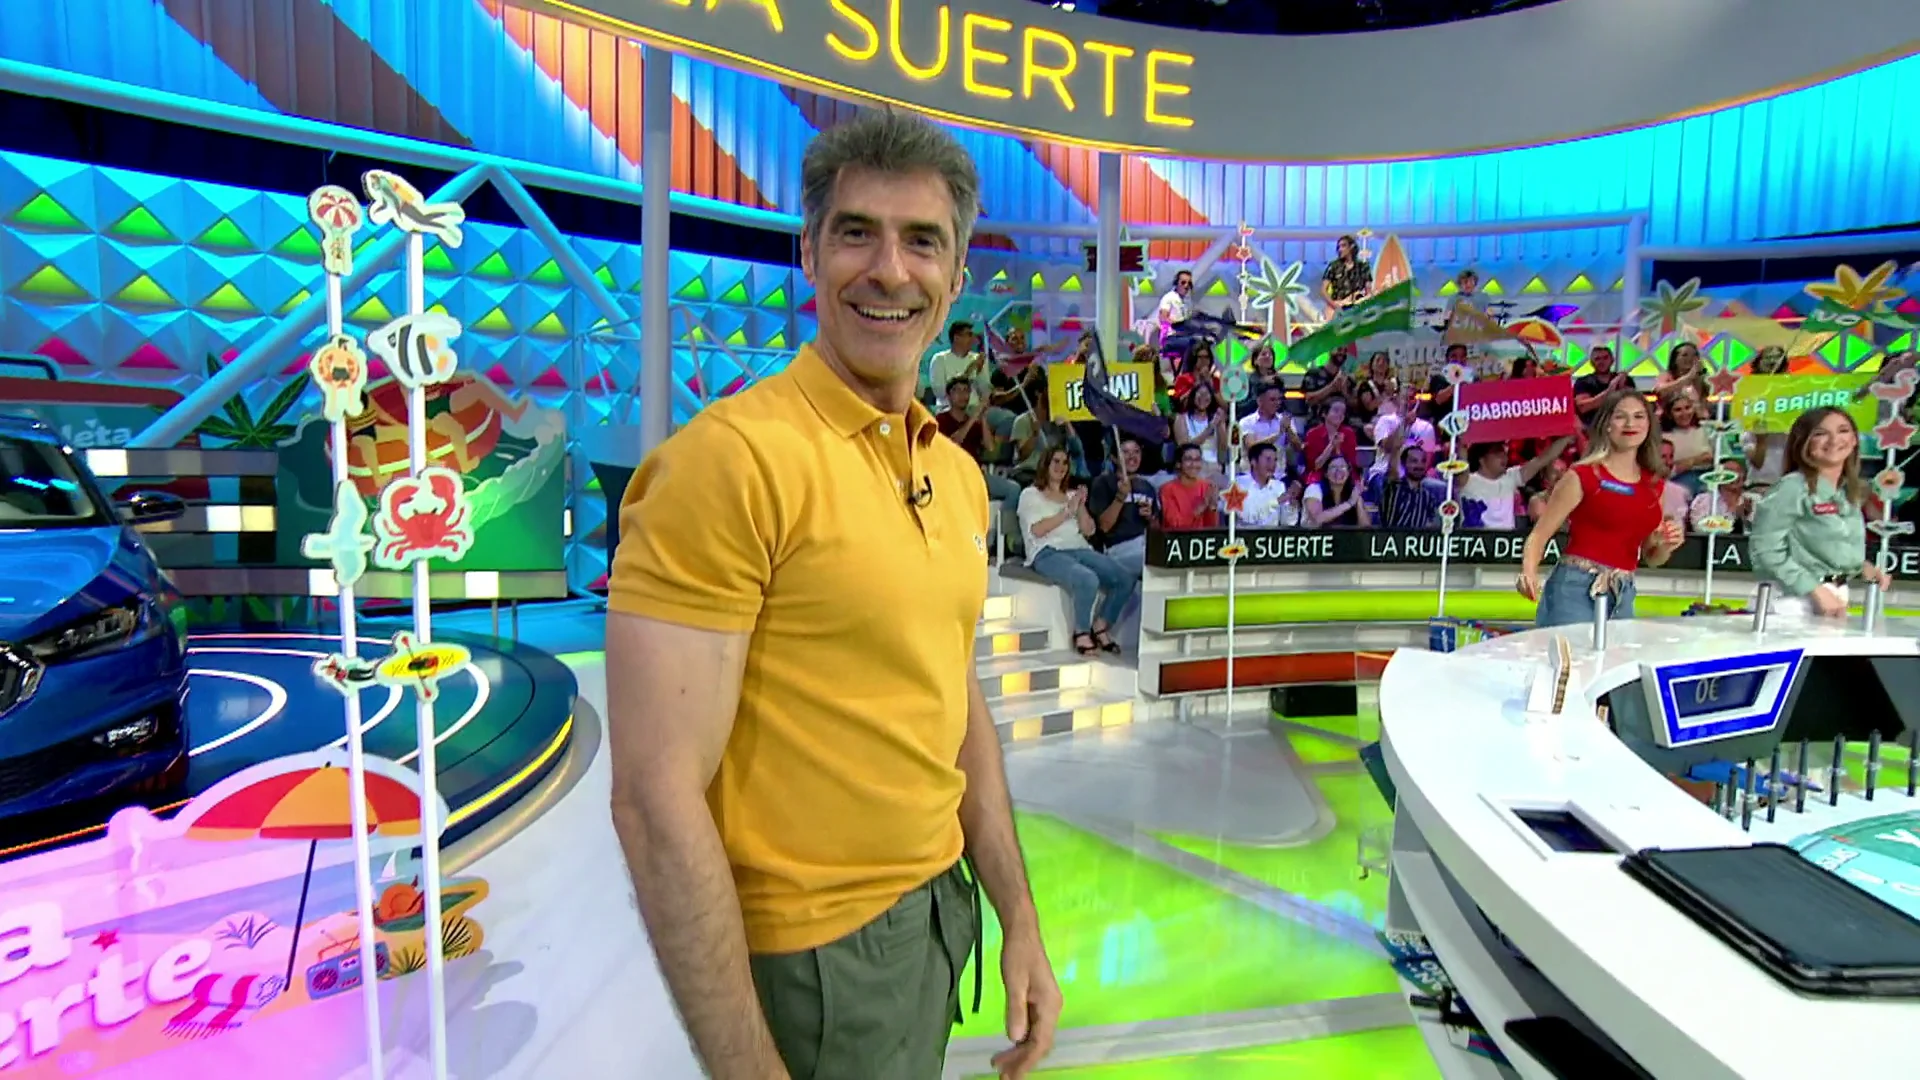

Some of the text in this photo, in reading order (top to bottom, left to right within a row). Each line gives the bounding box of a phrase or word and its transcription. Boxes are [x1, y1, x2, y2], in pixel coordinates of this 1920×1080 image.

[827, 0, 1195, 128] SUERTE
[1189, 538, 1216, 560] DE
[1255, 535, 1334, 559] SUERTE
[1371, 536, 1398, 557] LA
[1405, 536, 1487, 558] RULETA
[1494, 536, 1524, 558] DE
[1876, 551, 1920, 574] DE
